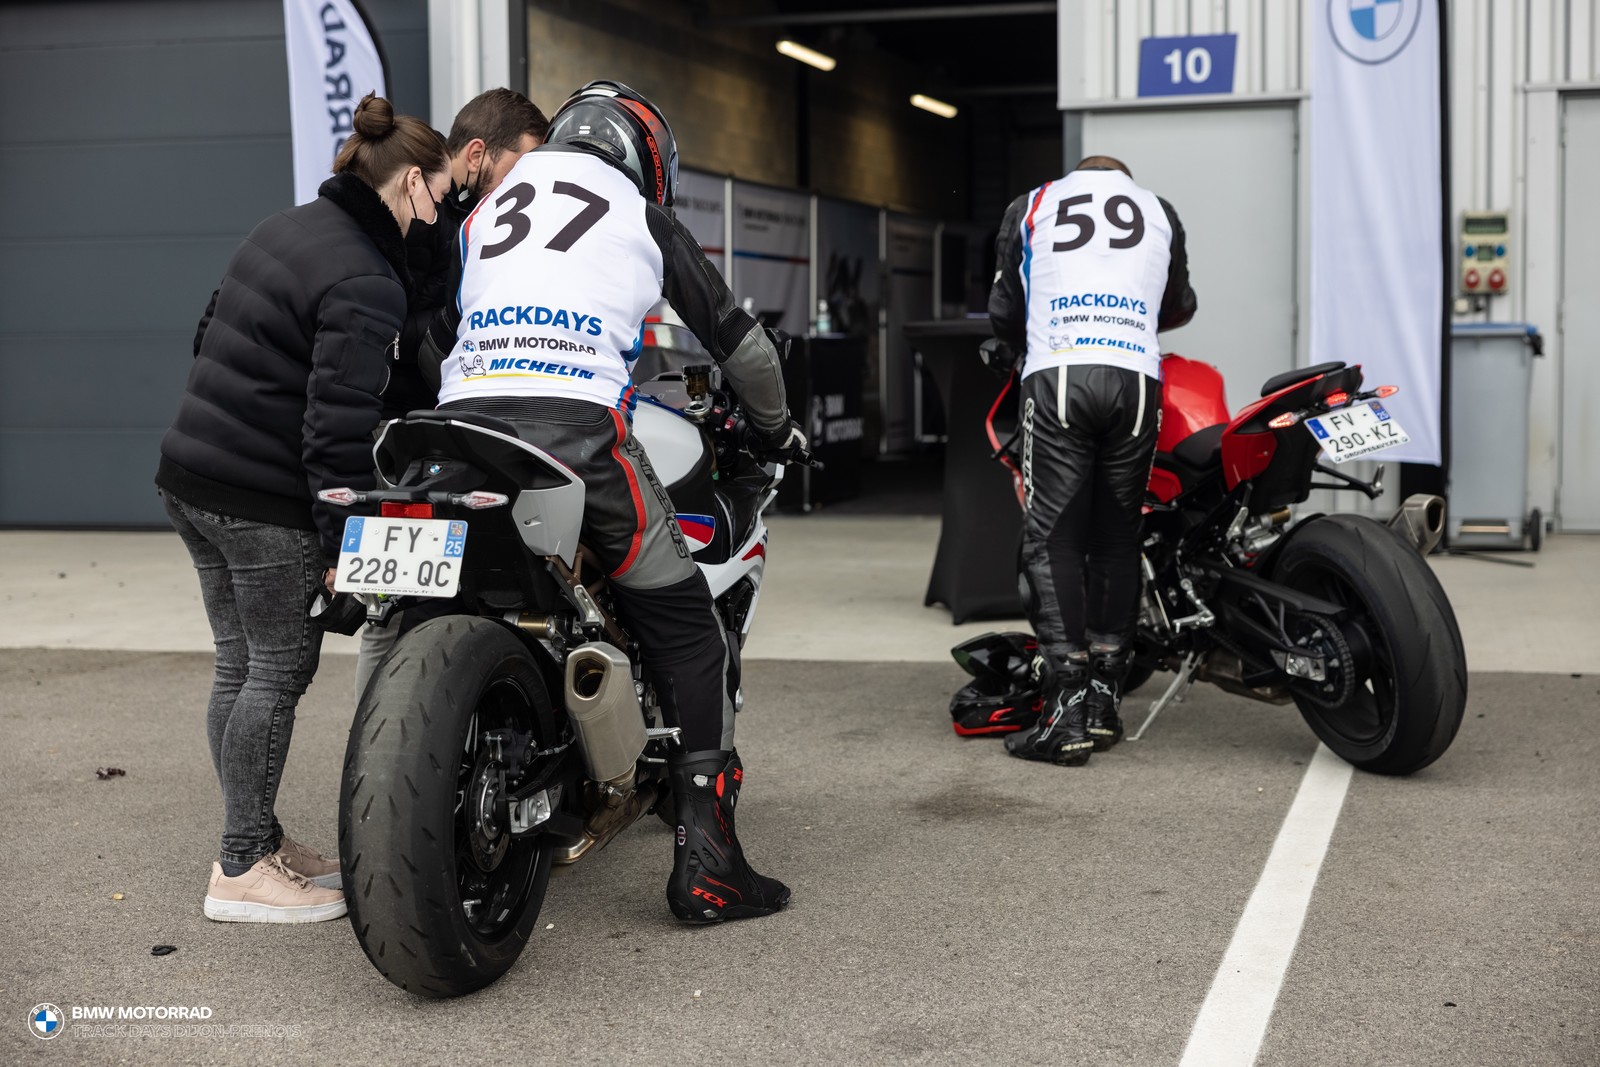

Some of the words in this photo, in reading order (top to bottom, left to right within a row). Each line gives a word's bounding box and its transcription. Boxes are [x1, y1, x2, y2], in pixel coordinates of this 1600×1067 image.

[1163, 47, 1212, 84] 10
[479, 180, 610, 260] 37
[1052, 193, 1145, 252] 59
[1050, 293, 1147, 315] TRACKDAYS
[468, 306, 602, 336] RACKDAYS
[1063, 315, 1090, 324] BMW
[1093, 315, 1146, 331] MOTORRAD
[479, 337, 510, 351] BMW
[514, 336, 597, 356] MOTORRAD
[1075, 337, 1146, 354] MICHELIN
[489, 358, 595, 380] MICHELIN
[348, 538, 356, 547] F
[445, 541, 463, 555] 25
